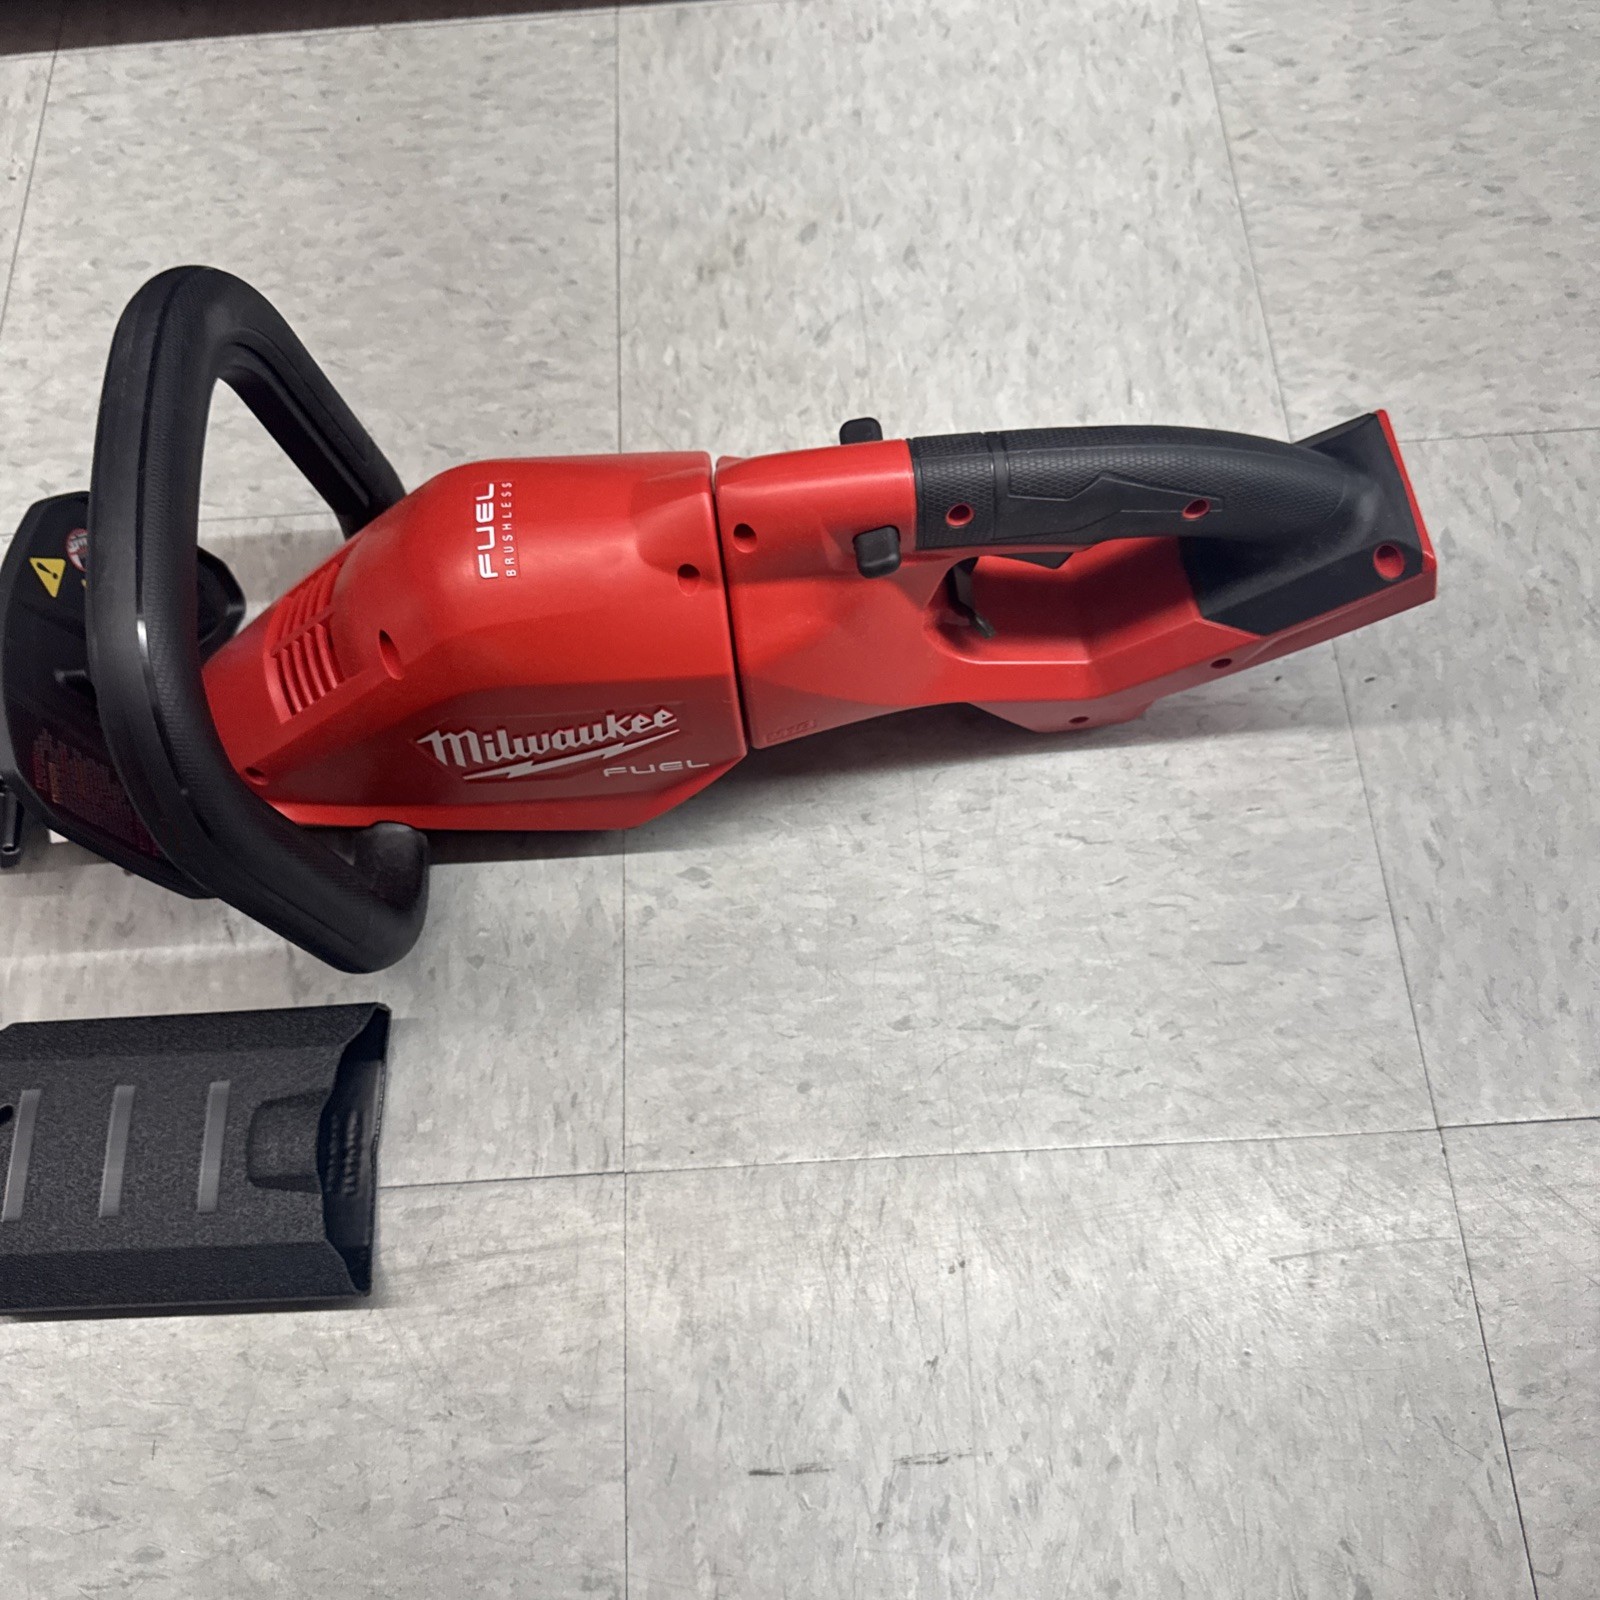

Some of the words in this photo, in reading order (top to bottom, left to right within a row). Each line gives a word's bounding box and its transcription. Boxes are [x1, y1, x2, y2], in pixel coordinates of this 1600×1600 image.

[475, 483, 499, 579] FUEL
[501, 482, 517, 577] BRUSHLESS
[417, 709, 677, 767] Milwaukee
[603, 759, 710, 777] FUEL
